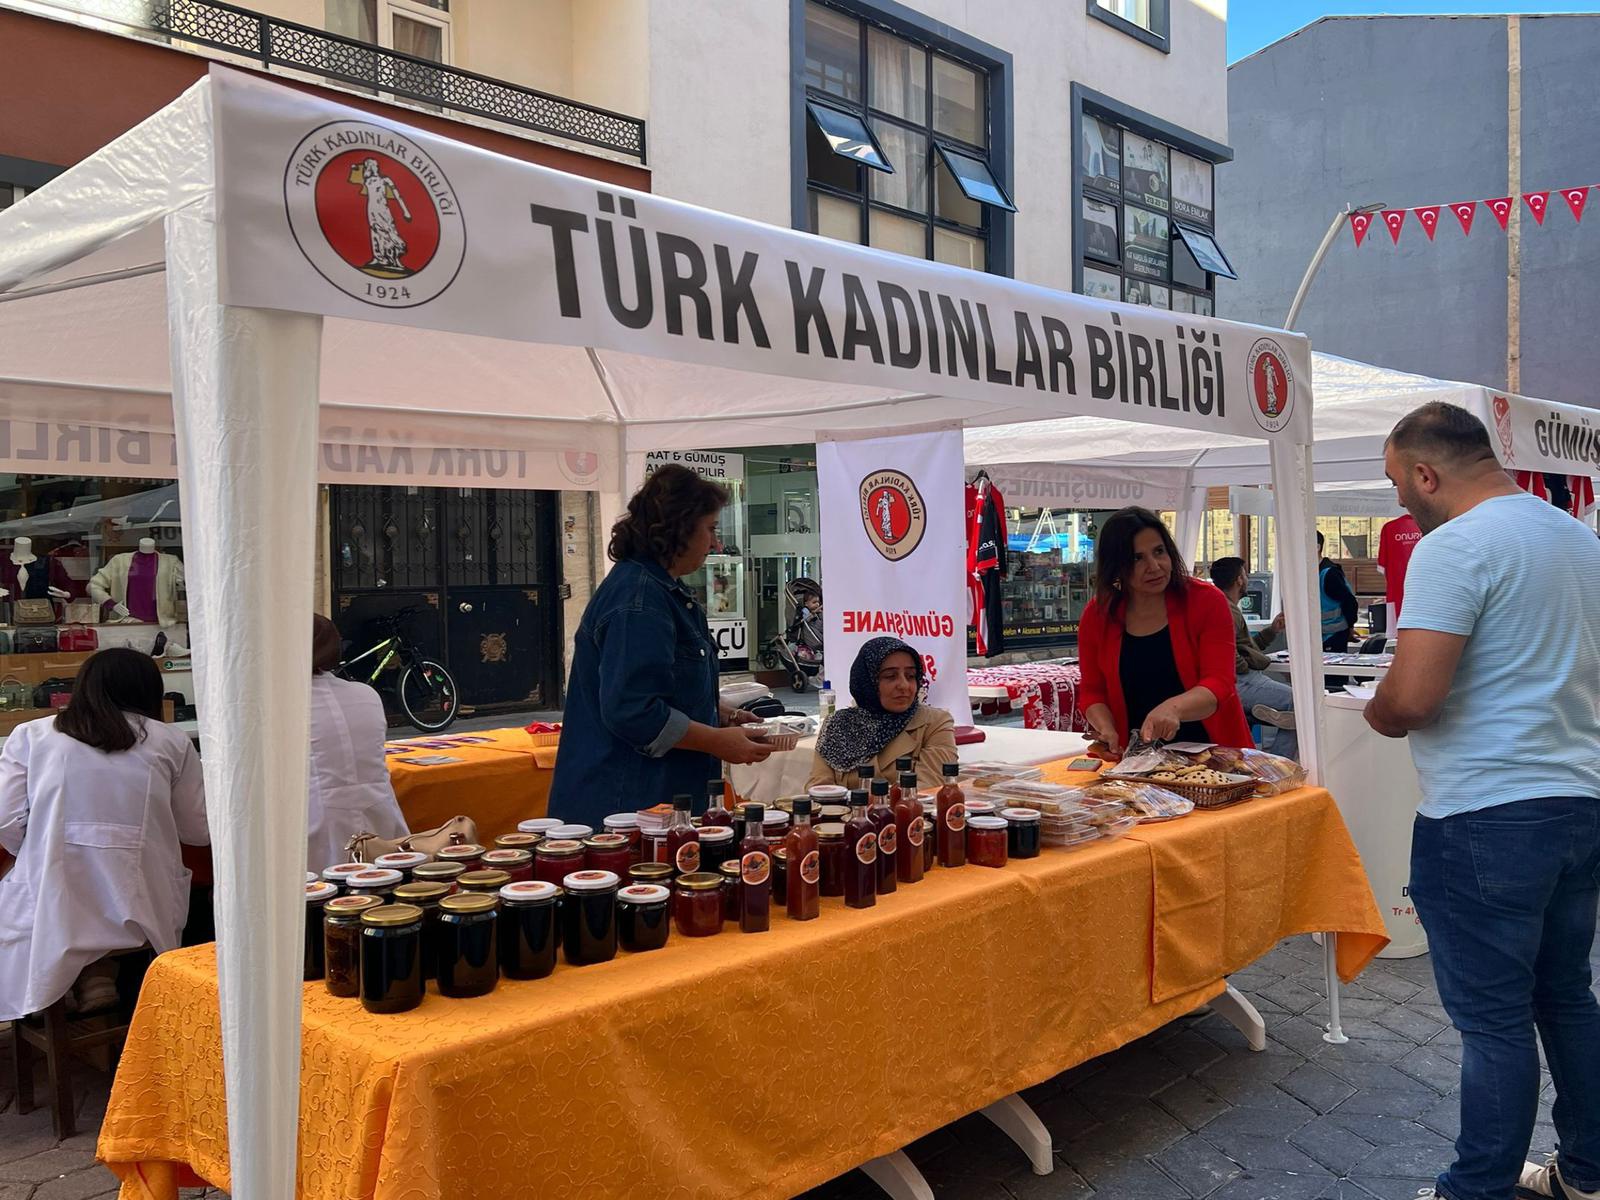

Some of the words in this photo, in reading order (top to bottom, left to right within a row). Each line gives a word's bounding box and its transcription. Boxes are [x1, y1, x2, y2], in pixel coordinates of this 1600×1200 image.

[296, 146, 327, 187] TÜRK
[324, 130, 408, 160] KADINLAR
[409, 155, 457, 216] BİRLİĞİ
[365, 283, 411, 300] 1924
[530, 190, 771, 350] TÜRK
[784, 259, 1077, 396] KADINLAR
[1084, 312, 1226, 418] BİRLİĞİ
[646, 450, 670, 461] AAT
[673, 452, 682, 461] &
[684, 452, 726, 465] GÜMÜŞ
[715, 622, 745, 657] ÇÜ
